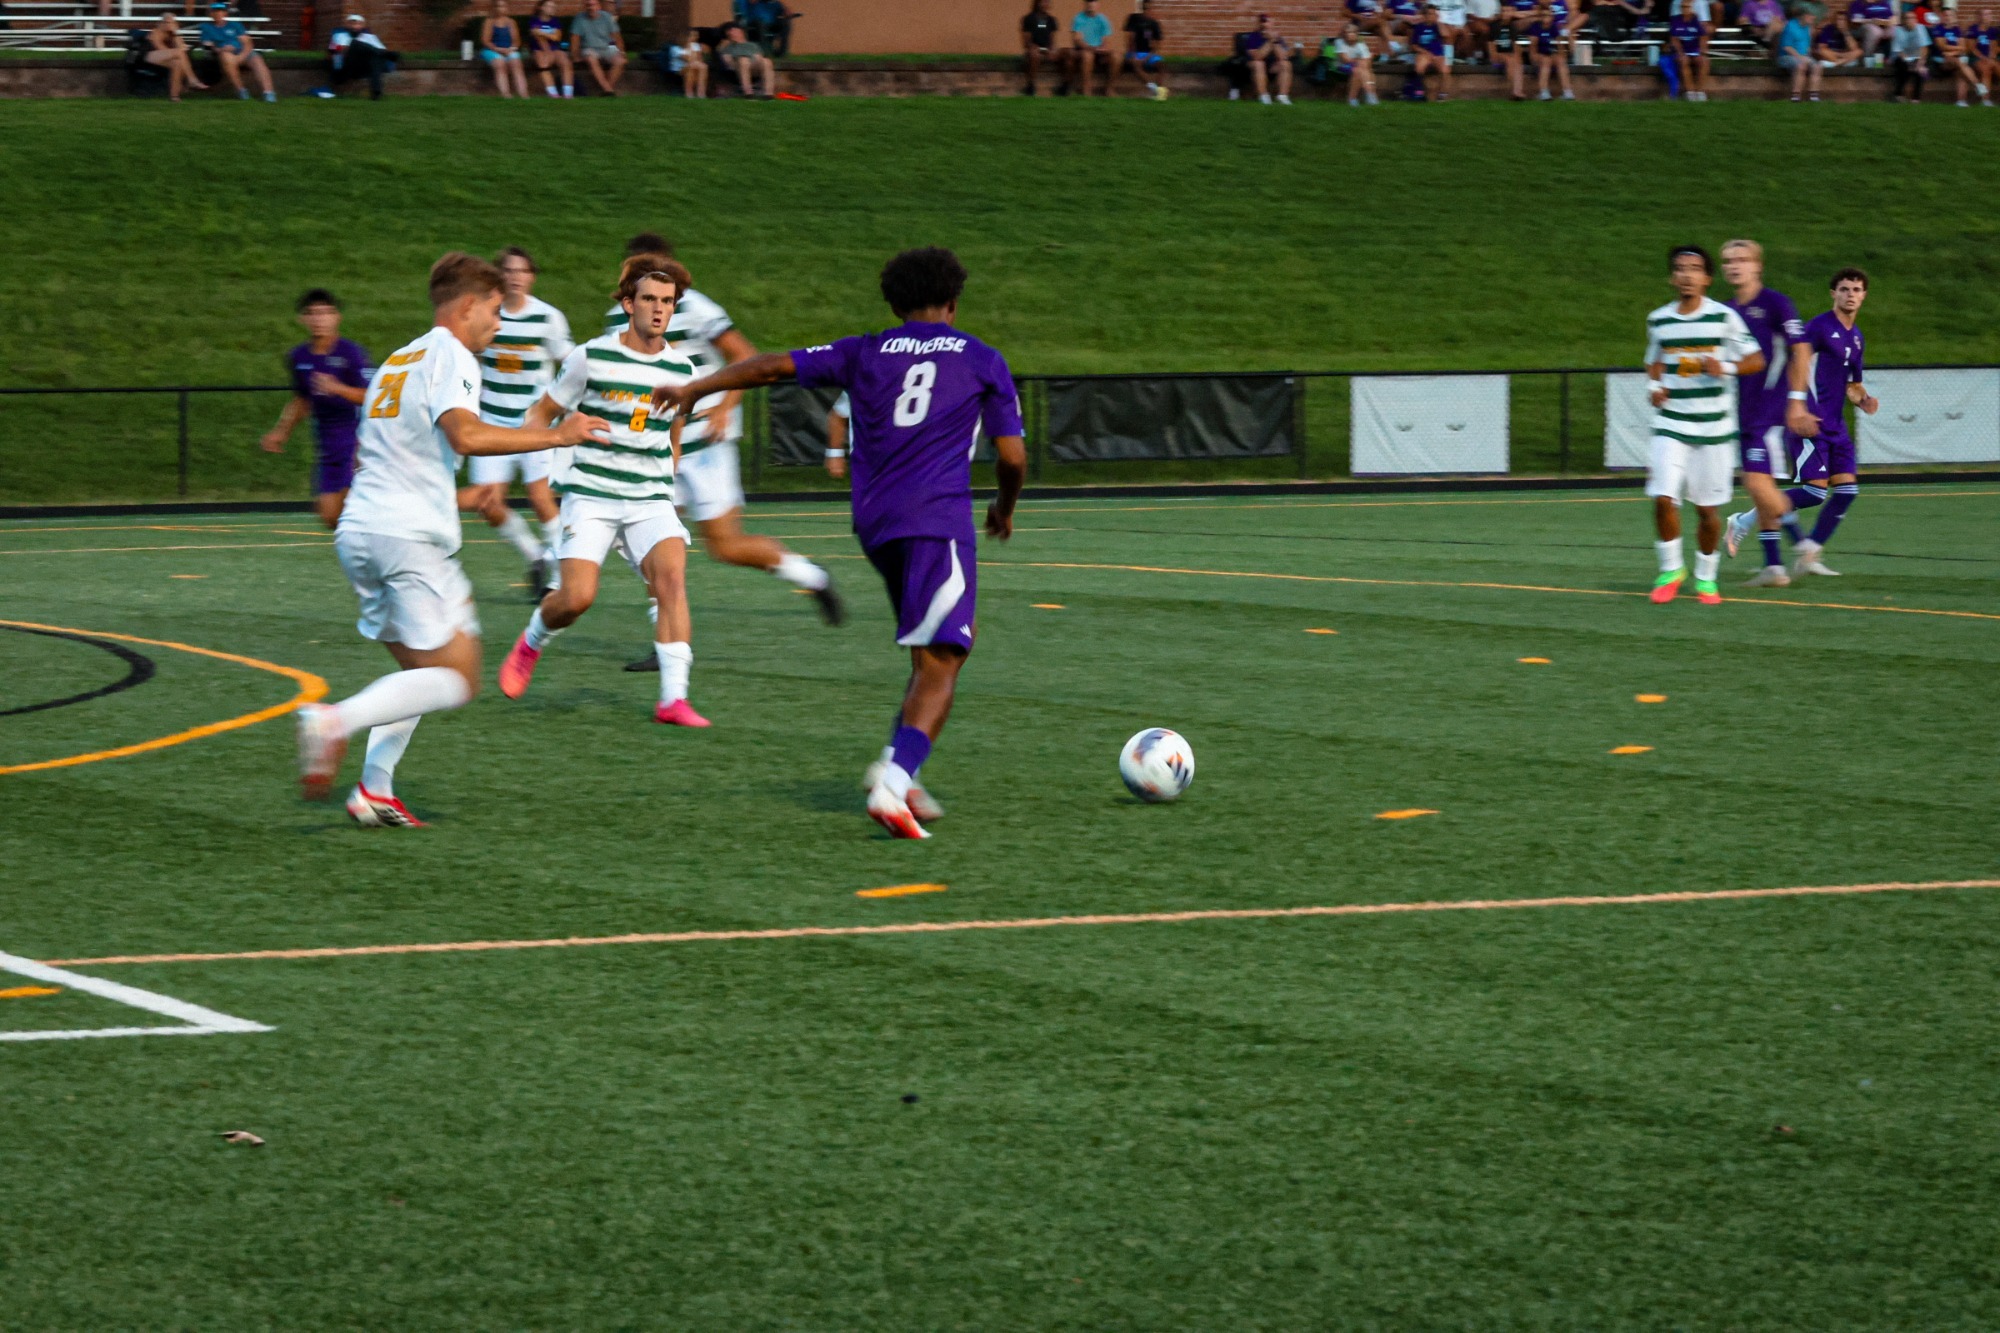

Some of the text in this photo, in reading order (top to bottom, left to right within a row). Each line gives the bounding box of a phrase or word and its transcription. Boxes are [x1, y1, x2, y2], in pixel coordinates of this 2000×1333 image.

[880, 336, 967, 355] CONVERSE
[893, 360, 937, 427] 8
[629, 407, 650, 432] 6
